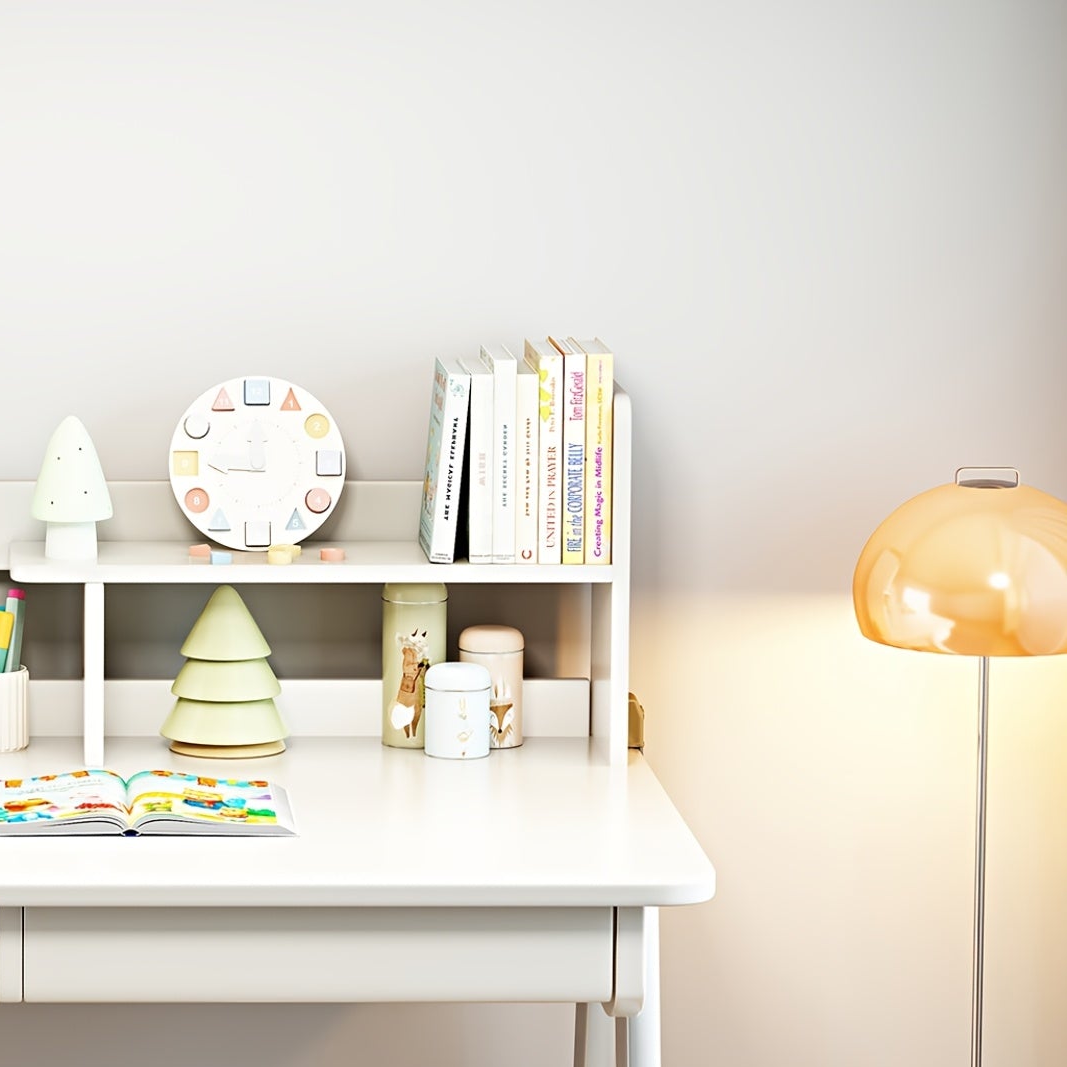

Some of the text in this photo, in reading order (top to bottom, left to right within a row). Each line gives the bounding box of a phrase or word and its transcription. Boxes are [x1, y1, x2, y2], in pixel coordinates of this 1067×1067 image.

[546, 446, 556, 487] PRAYER
[594, 447, 603, 478] Midlife
[566, 443, 583, 552] FIRE in the CORPORATE BELLY
[594, 491, 604, 517] Magic
[546, 501, 556, 548] UNITED
[593, 519, 604, 557] Creating
